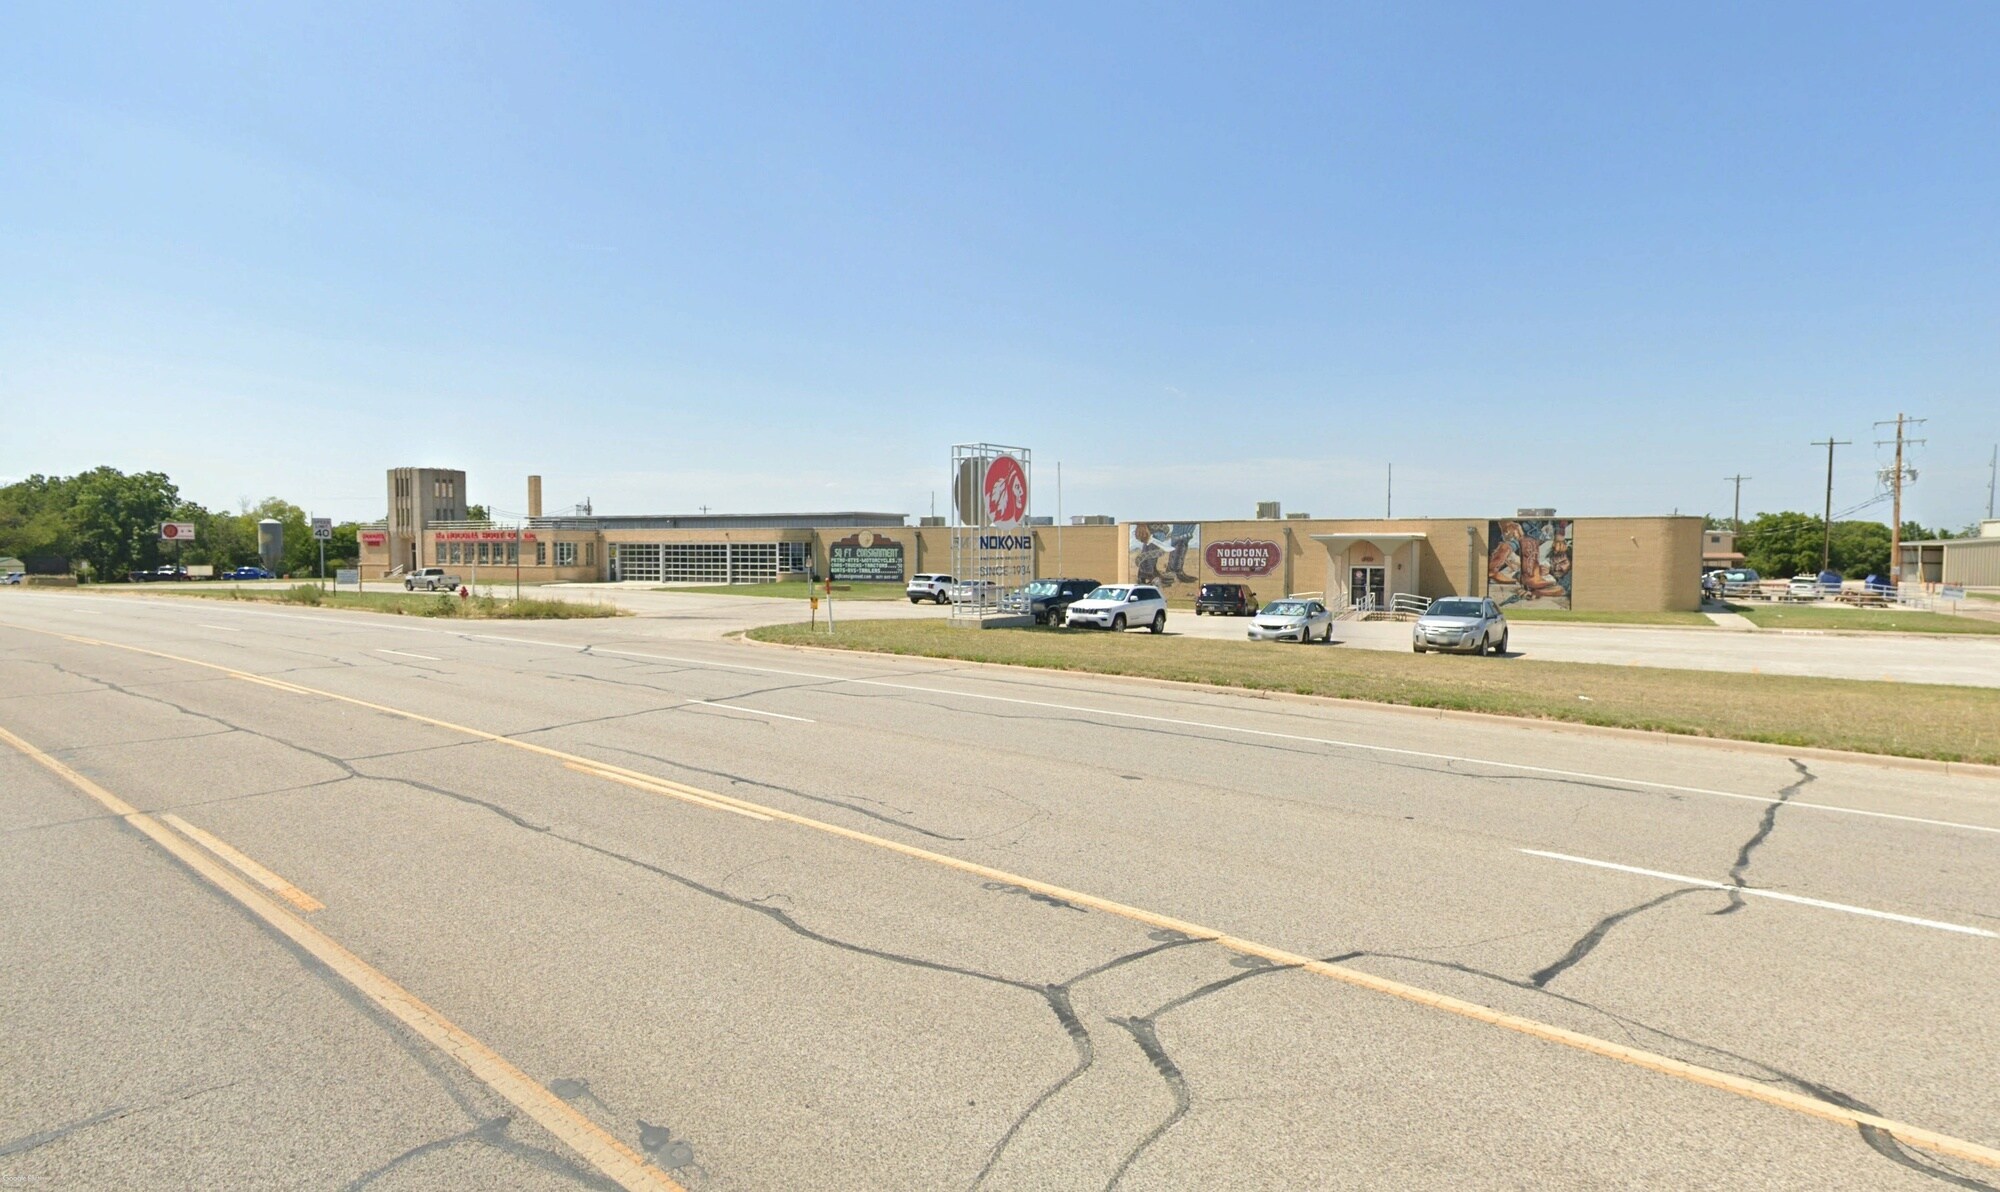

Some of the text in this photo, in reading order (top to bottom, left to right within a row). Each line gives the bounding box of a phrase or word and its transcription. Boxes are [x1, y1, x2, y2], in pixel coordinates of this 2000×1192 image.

[315, 529, 330, 537] 40
[856, 548, 899, 557] CONSIGNMENT
[979, 565, 1031, 576] SINCE 1934
